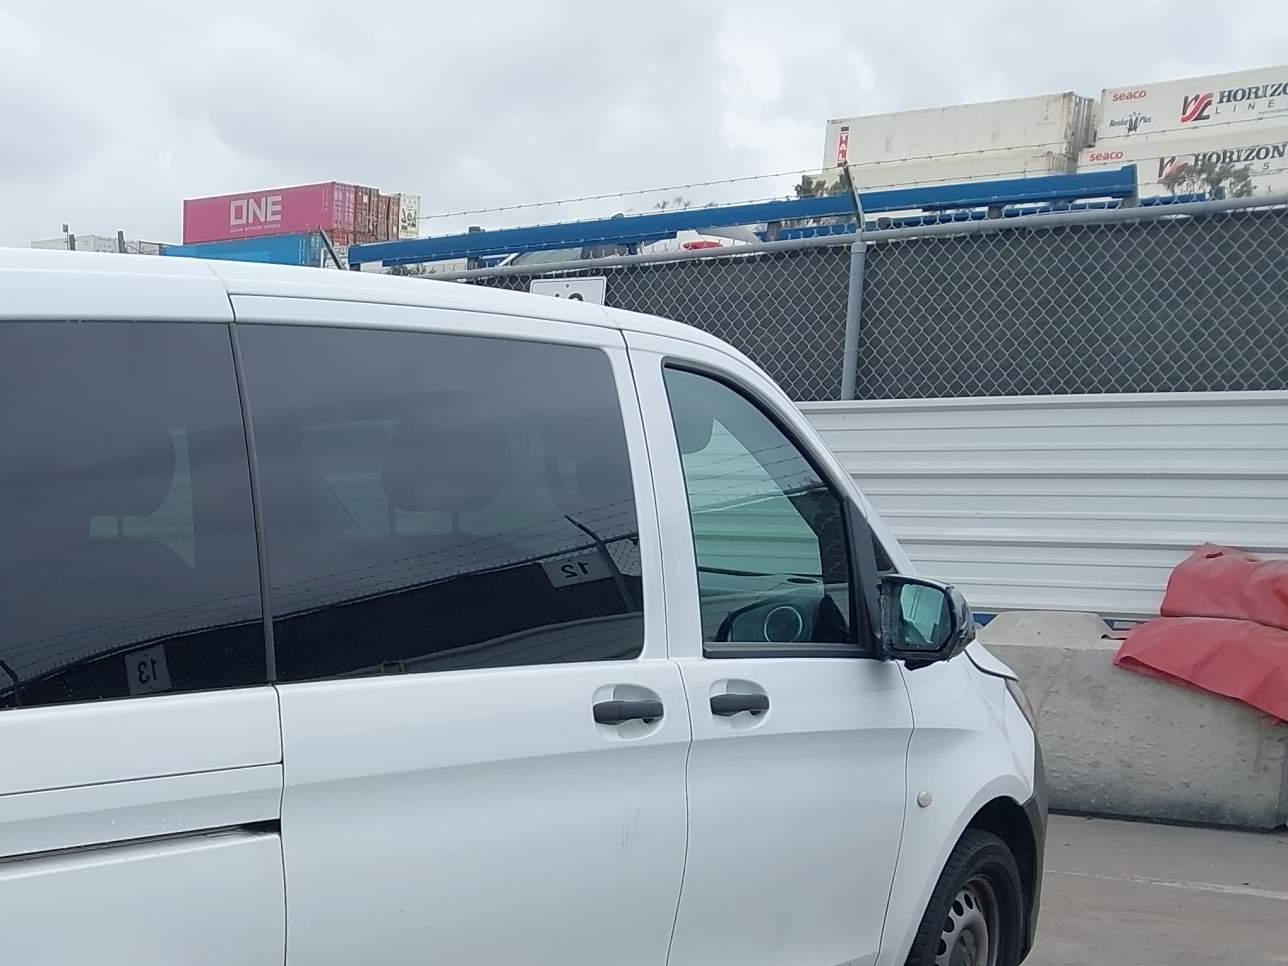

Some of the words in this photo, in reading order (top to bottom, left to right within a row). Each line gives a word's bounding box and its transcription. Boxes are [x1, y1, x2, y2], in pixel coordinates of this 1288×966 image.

[1112, 89, 1146, 101] seaco
[1089, 151, 1123, 162] seaco
[230, 195, 282, 225] ONE
